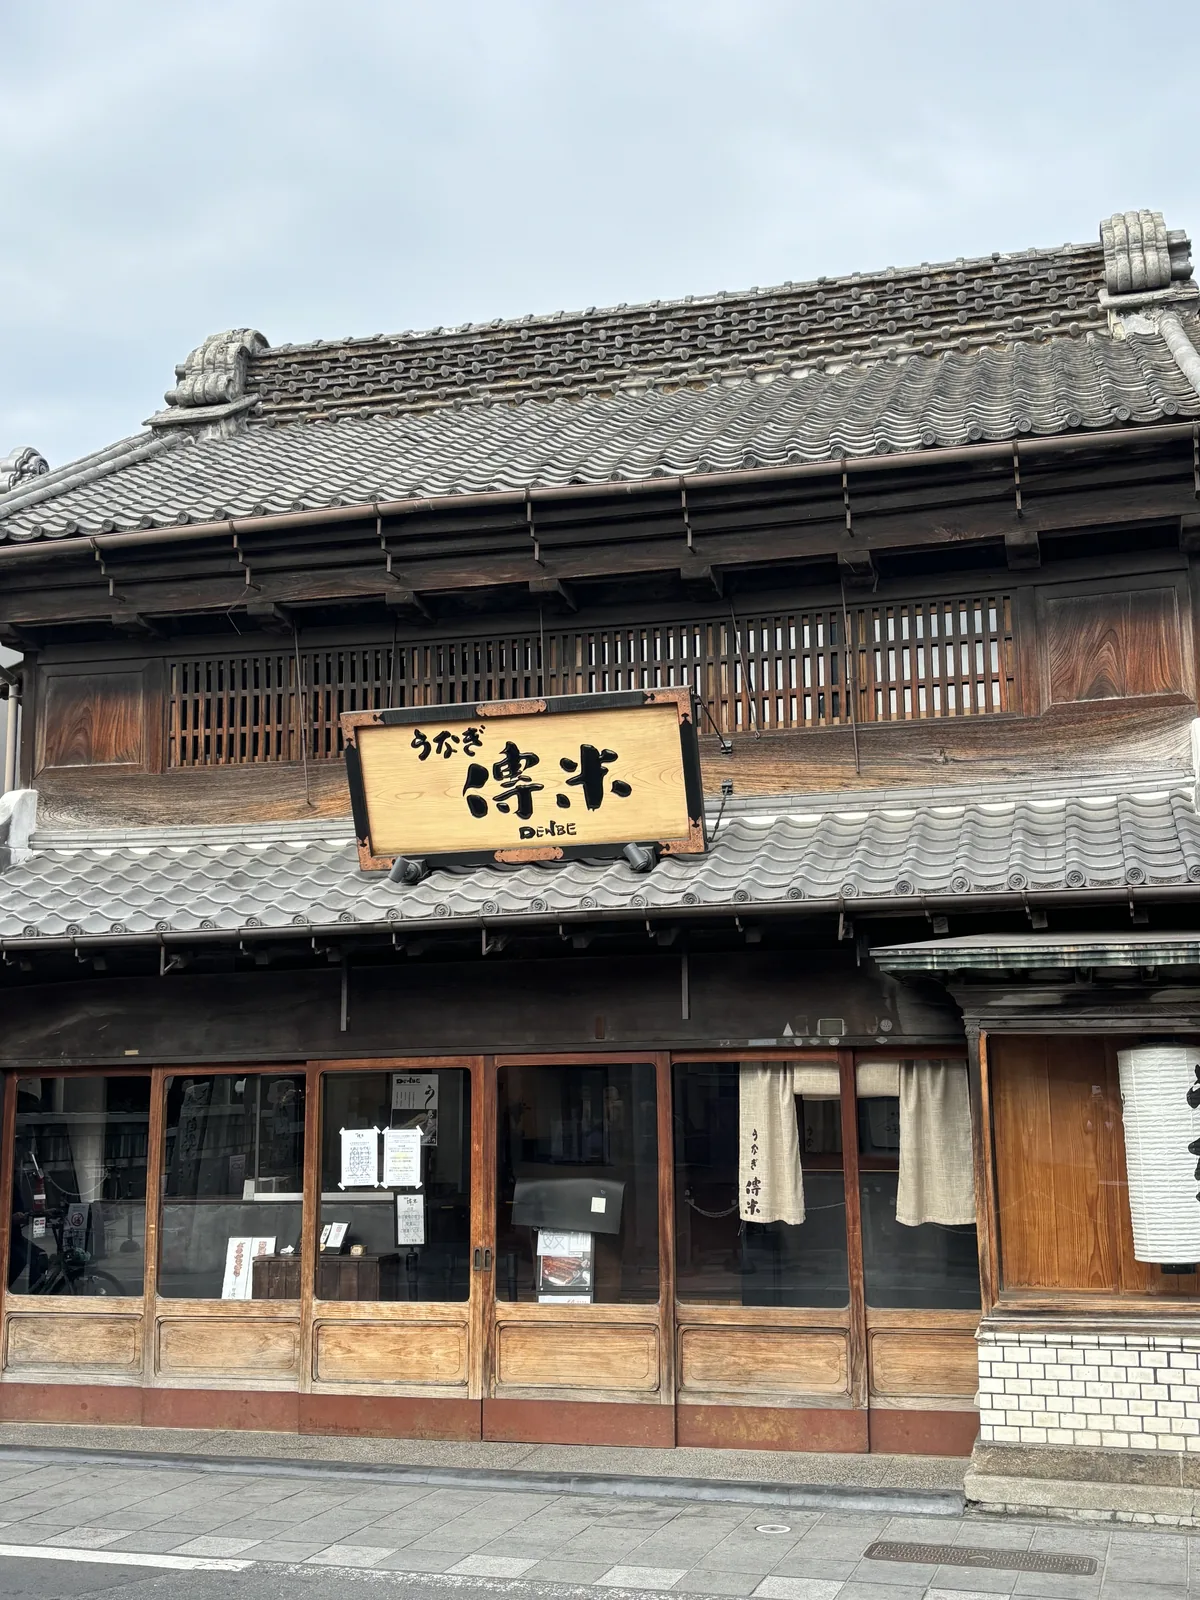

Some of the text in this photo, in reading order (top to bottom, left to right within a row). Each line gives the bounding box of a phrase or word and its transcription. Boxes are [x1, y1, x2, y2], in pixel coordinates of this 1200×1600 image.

[410, 725, 486, 761] うなぎ
[519, 820, 577, 840] DENBE
[751, 1128, 759, 1171] うなぎ
